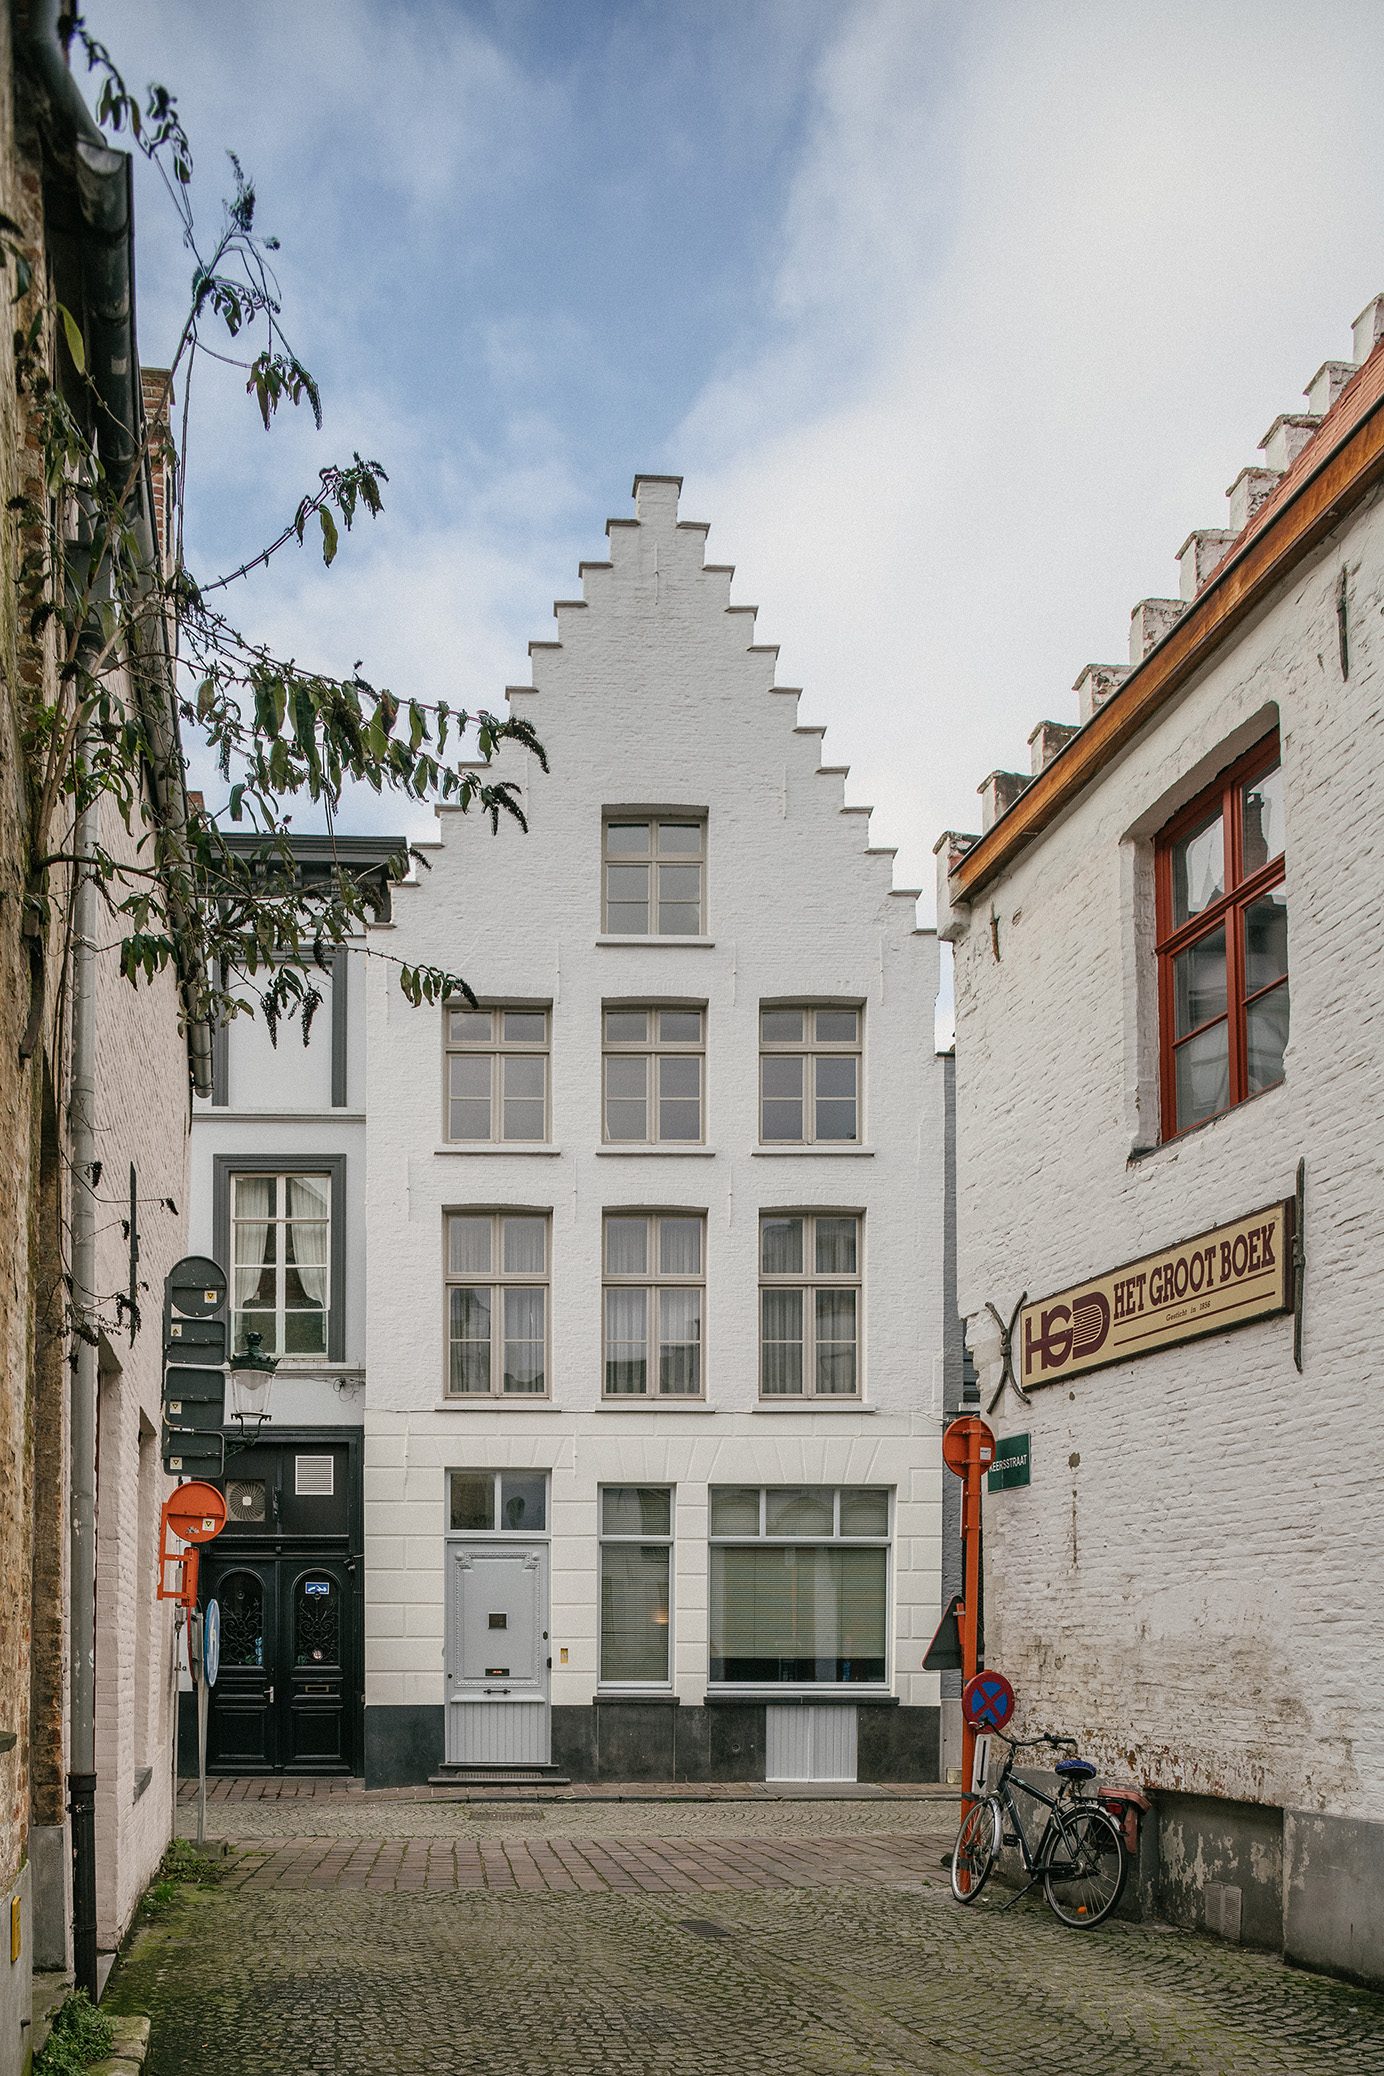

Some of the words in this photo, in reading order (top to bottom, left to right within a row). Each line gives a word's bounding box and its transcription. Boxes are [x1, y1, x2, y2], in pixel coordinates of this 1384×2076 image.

[1113, 1273, 1147, 1320] HET
[1149, 1245, 1216, 1306] GROOT
[1220, 1222, 1276, 1284] BOEK
